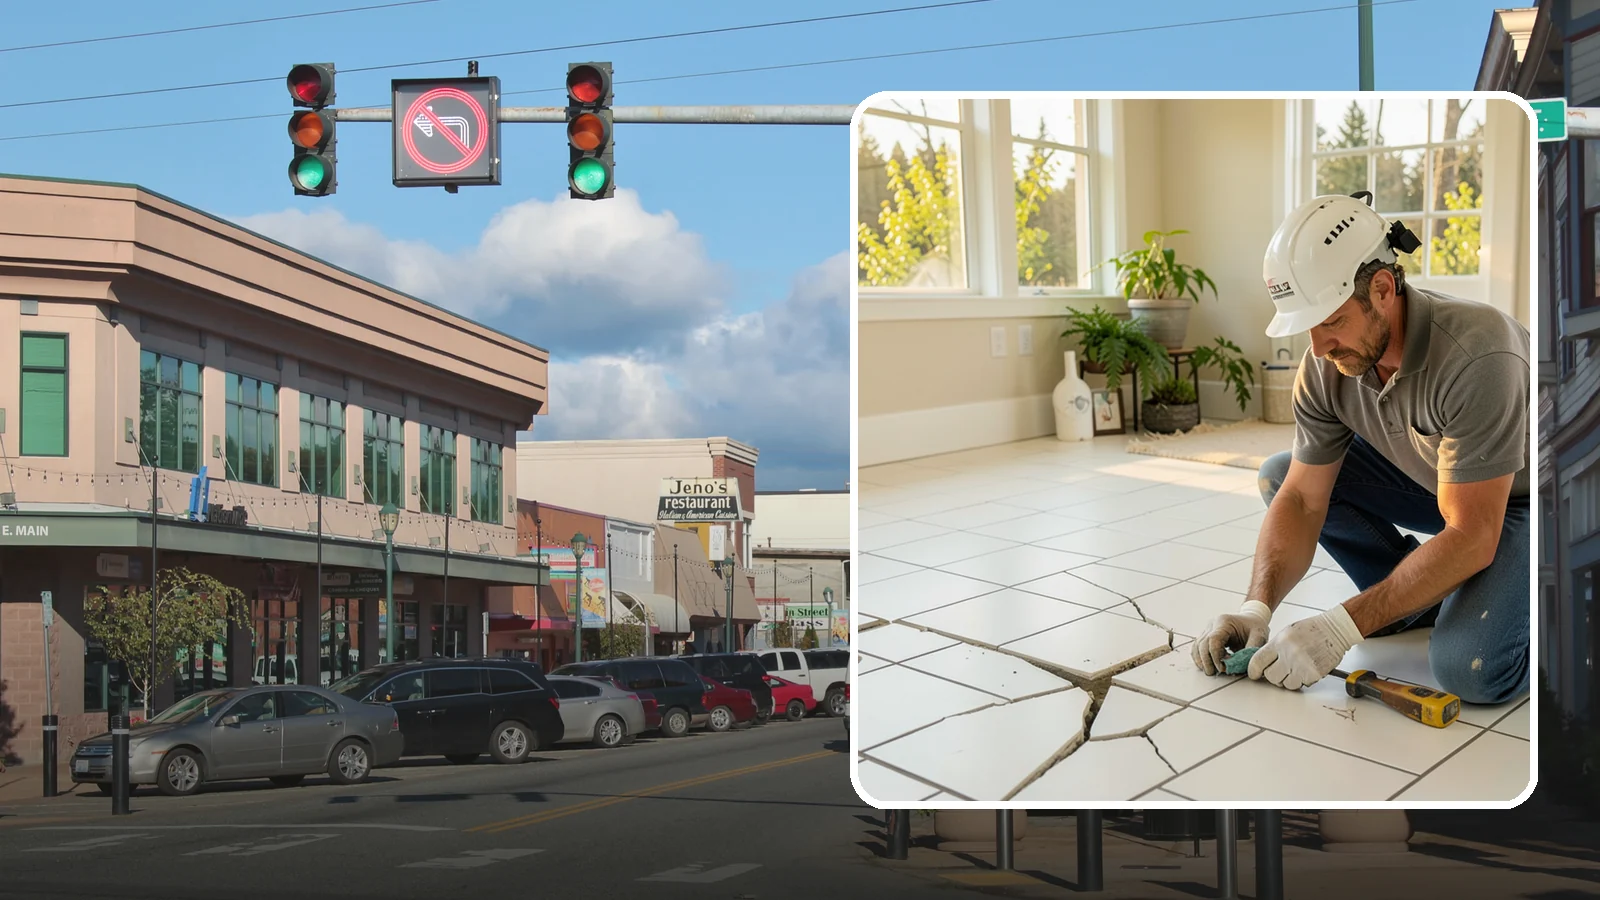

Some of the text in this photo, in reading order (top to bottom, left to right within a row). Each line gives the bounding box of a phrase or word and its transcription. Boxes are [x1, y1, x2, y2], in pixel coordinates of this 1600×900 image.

[669, 480, 728, 494] Jeno's
[665, 496, 731, 509] restaurant
[658, 510, 681, 519] Italian
[686, 509, 714, 519] American
[715, 509, 738, 519] Cuisine
[2, 525, 49, 536] E. MAIN
[797, 608, 828, 616] Street
[791, 619, 823, 627] lass
